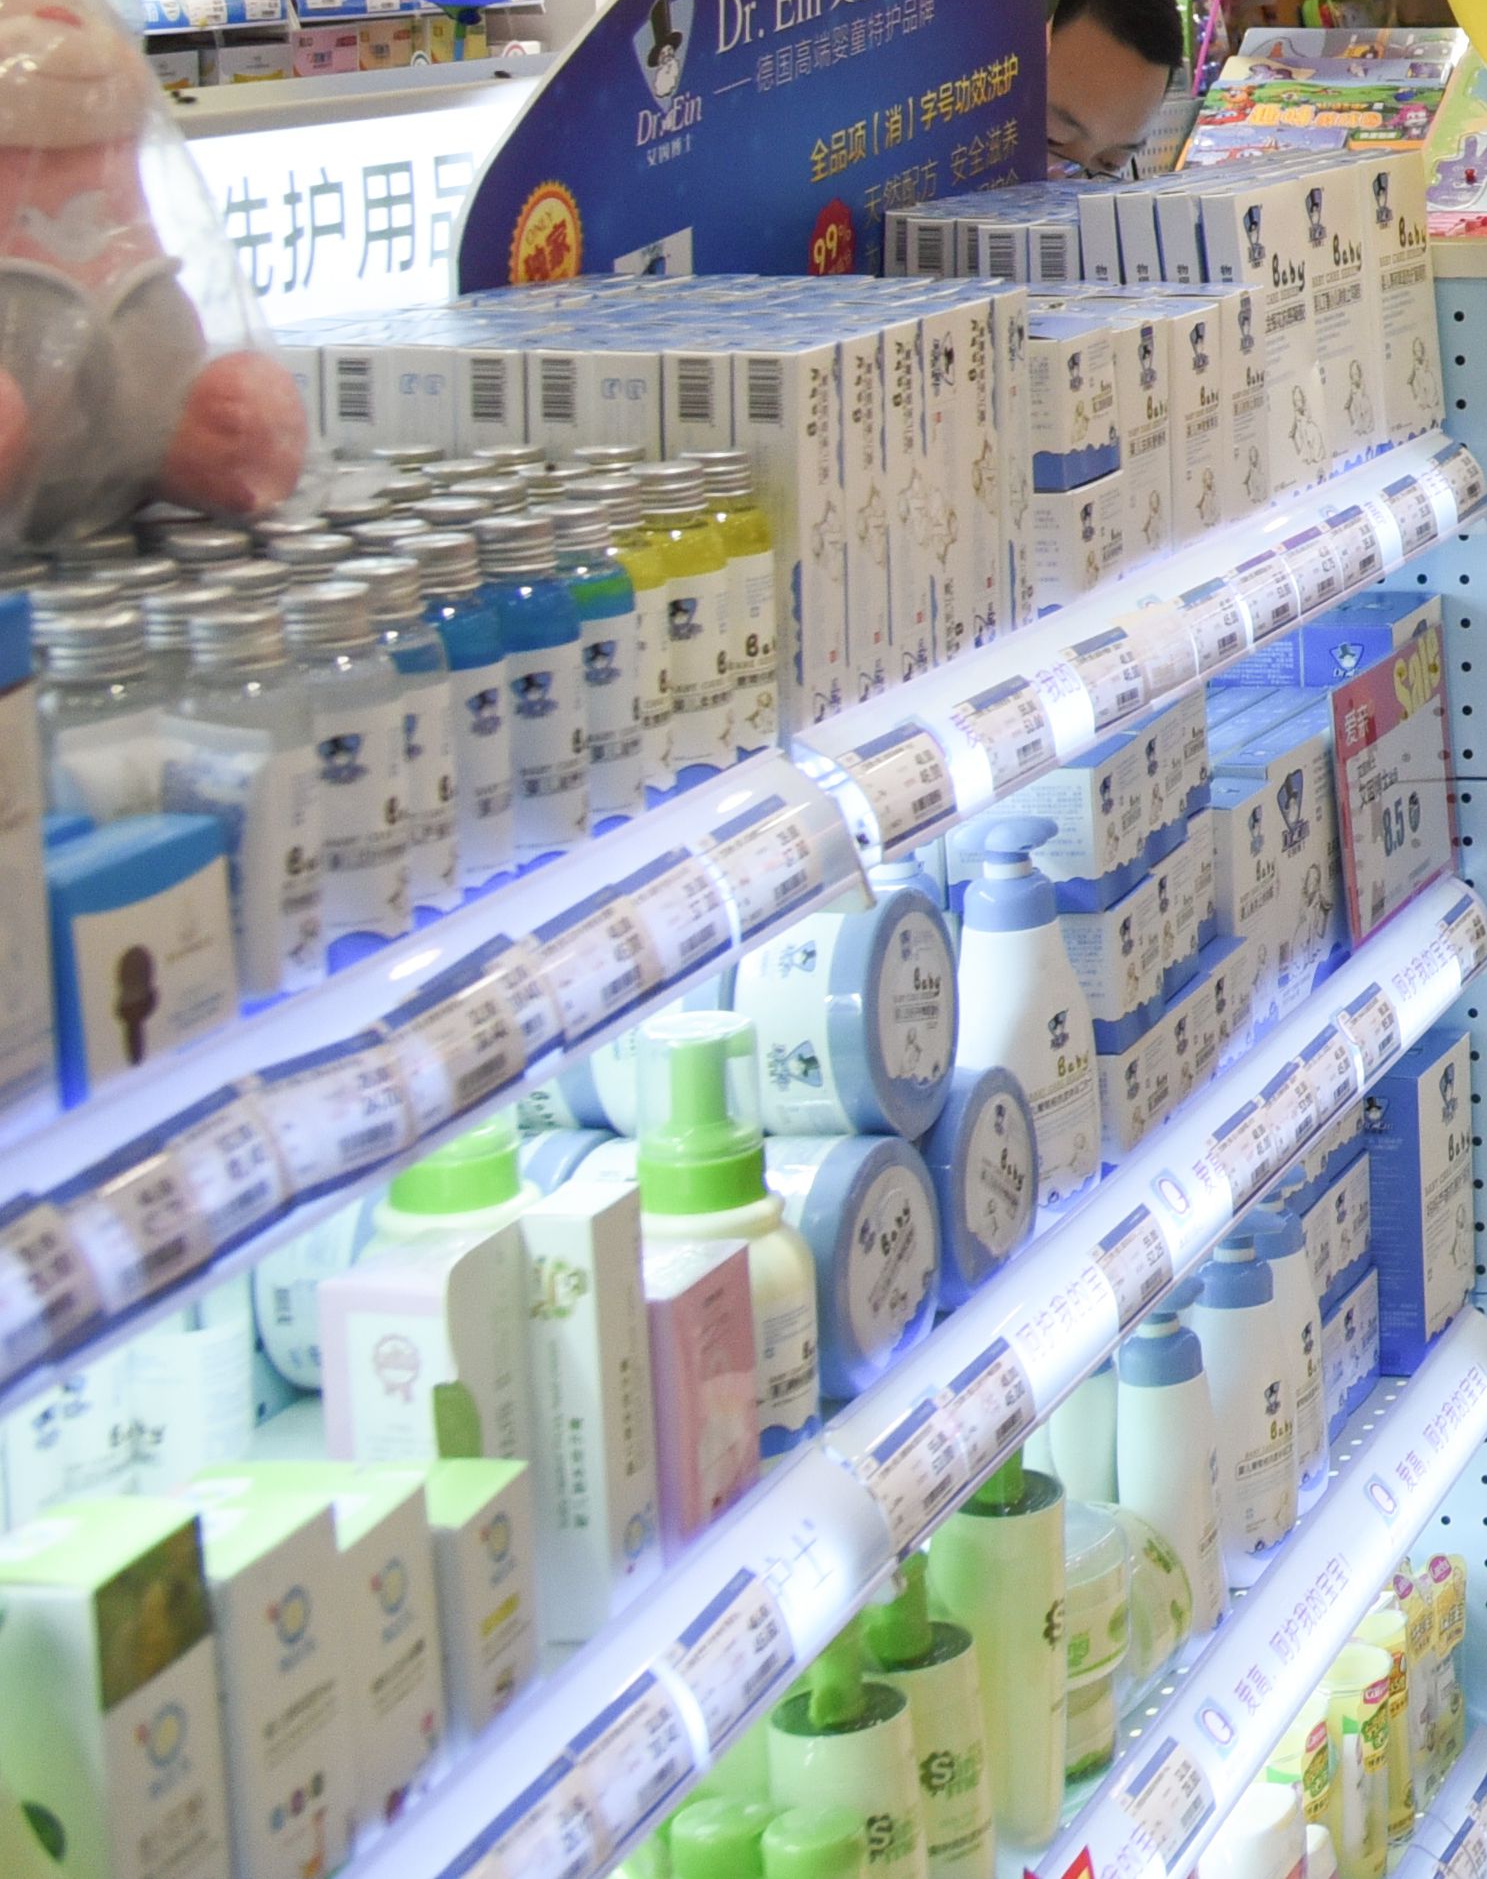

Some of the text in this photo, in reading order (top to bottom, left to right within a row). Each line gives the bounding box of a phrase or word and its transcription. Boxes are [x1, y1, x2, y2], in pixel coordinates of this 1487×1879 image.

[863, 158, 938, 218] 天然配方
[1332, 232, 1362, 267] Baby
[1398, 216, 1428, 254] Baby
[1271, 252, 1306, 292] Baby
[1393, 621, 1441, 721] Sale
[1345, 701, 1376, 746] 爱亲
[913, 967, 941, 997] Baby
[1056, 1049, 1090, 1079] Baby
[1269, 1419, 1294, 1440] Baby
